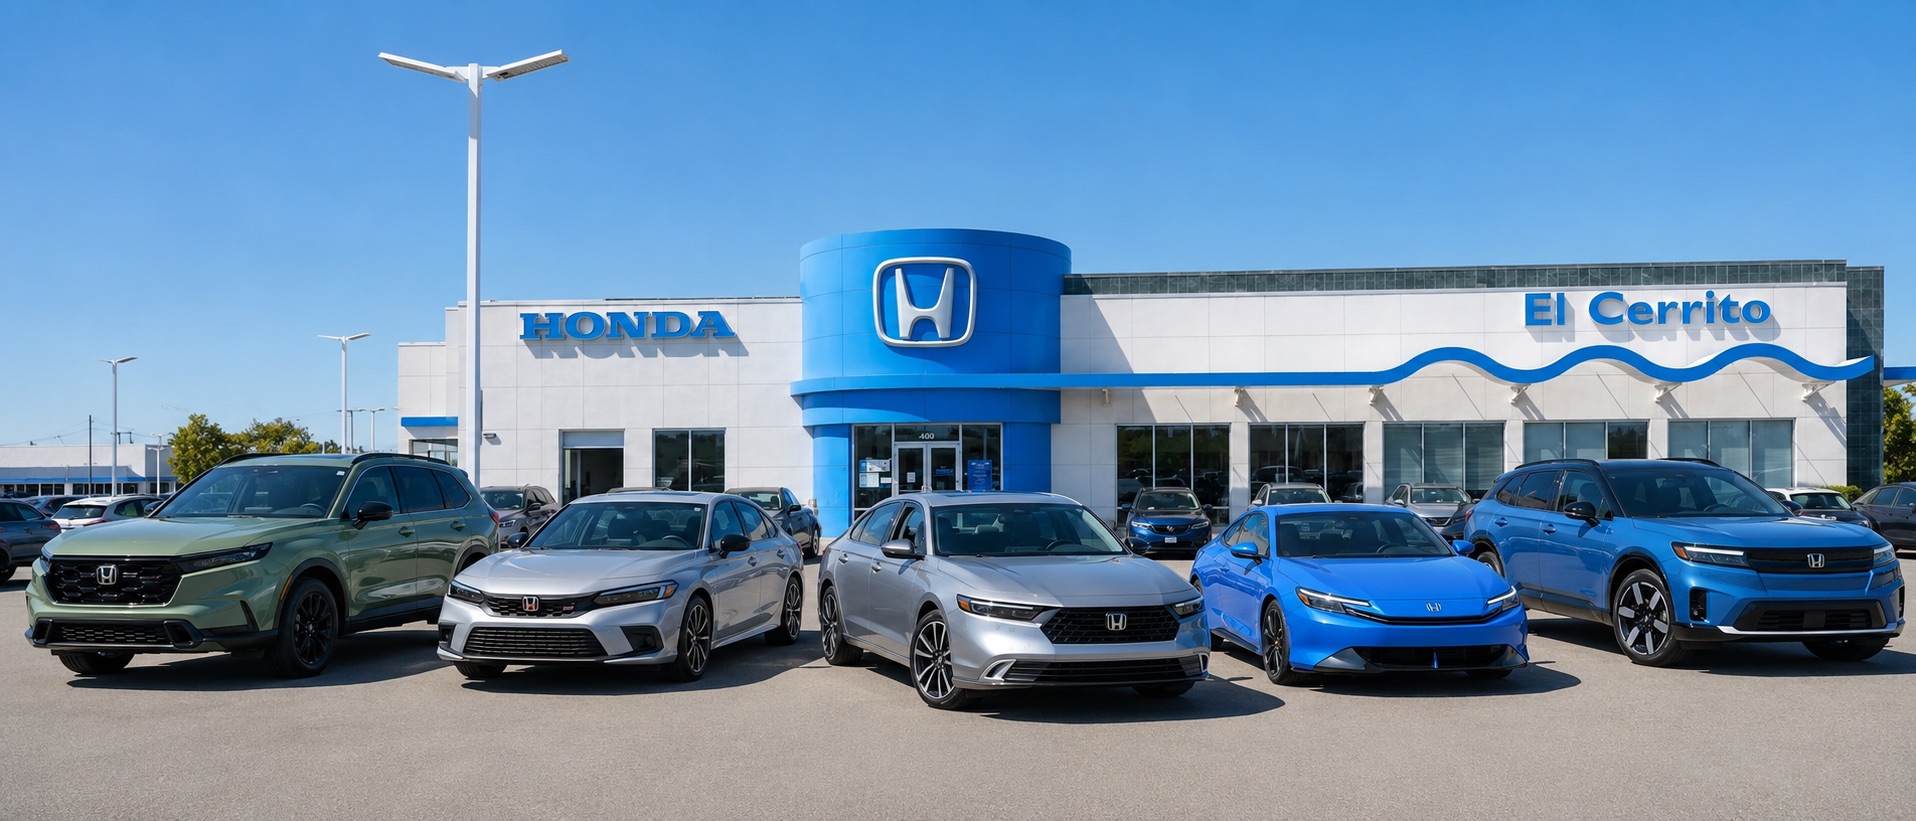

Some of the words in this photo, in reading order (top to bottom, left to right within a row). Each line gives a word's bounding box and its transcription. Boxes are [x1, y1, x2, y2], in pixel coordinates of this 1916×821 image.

[894, 267, 955, 340] H
[1524, 292, 1565, 326] El
[1588, 290, 1771, 326] Cerrito
[519, 310, 736, 340] HONDA
